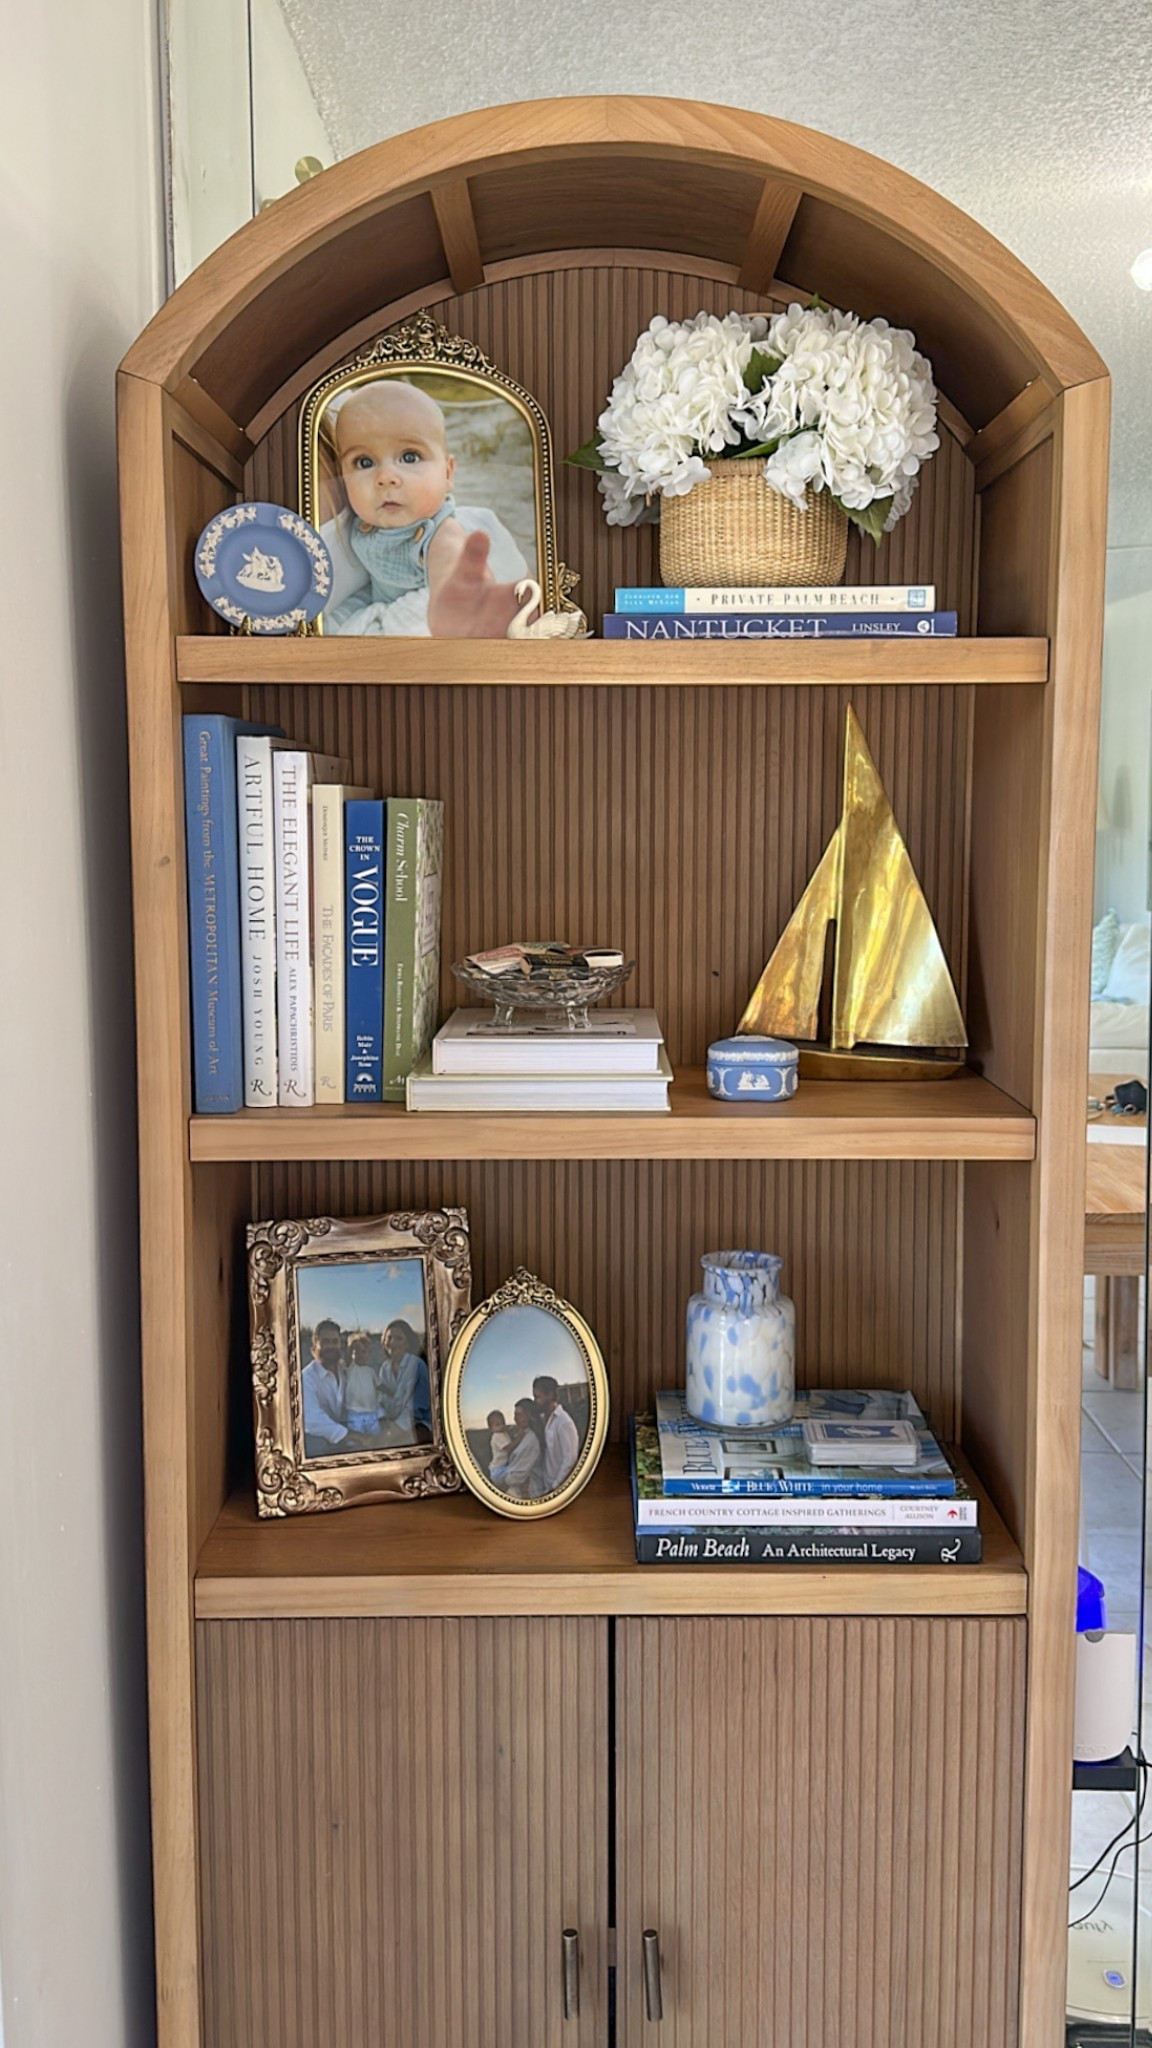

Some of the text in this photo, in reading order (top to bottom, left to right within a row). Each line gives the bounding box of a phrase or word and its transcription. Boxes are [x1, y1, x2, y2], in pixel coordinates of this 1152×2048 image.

[711, 593, 879, 605] PRIVATE PALM BEACH
[625, 619, 827, 639] NANTUCKET
[852, 623, 900, 632] LINSLEY
[244, 755, 266, 940] ARTFUL HOME
[395, 813, 409, 901] Charm School
[282, 766, 299, 961] THE ELEGANT LIFE
[197, 731, 220, 1074] Great Paintings from the METROPOLITAN Museum of Art
[351, 865, 379, 966] VOGUE
[322, 905, 334, 929] THE
[322, 984, 333, 998] OF
[253, 955, 264, 1065] JOSH YOUNG
[289, 967, 298, 1072] ALEX PAPACHRISTIDIS
[323, 1001, 335, 1032] PARIS
[747, 1480, 883, 1493] BLUE WHITE in your home
[649, 1508, 887, 1517] FRENCH COUNTRY COTTAGE INSPIRED GATHERINGS
[656, 1536, 916, 1561] Palm Beach An Architectural Legacy
